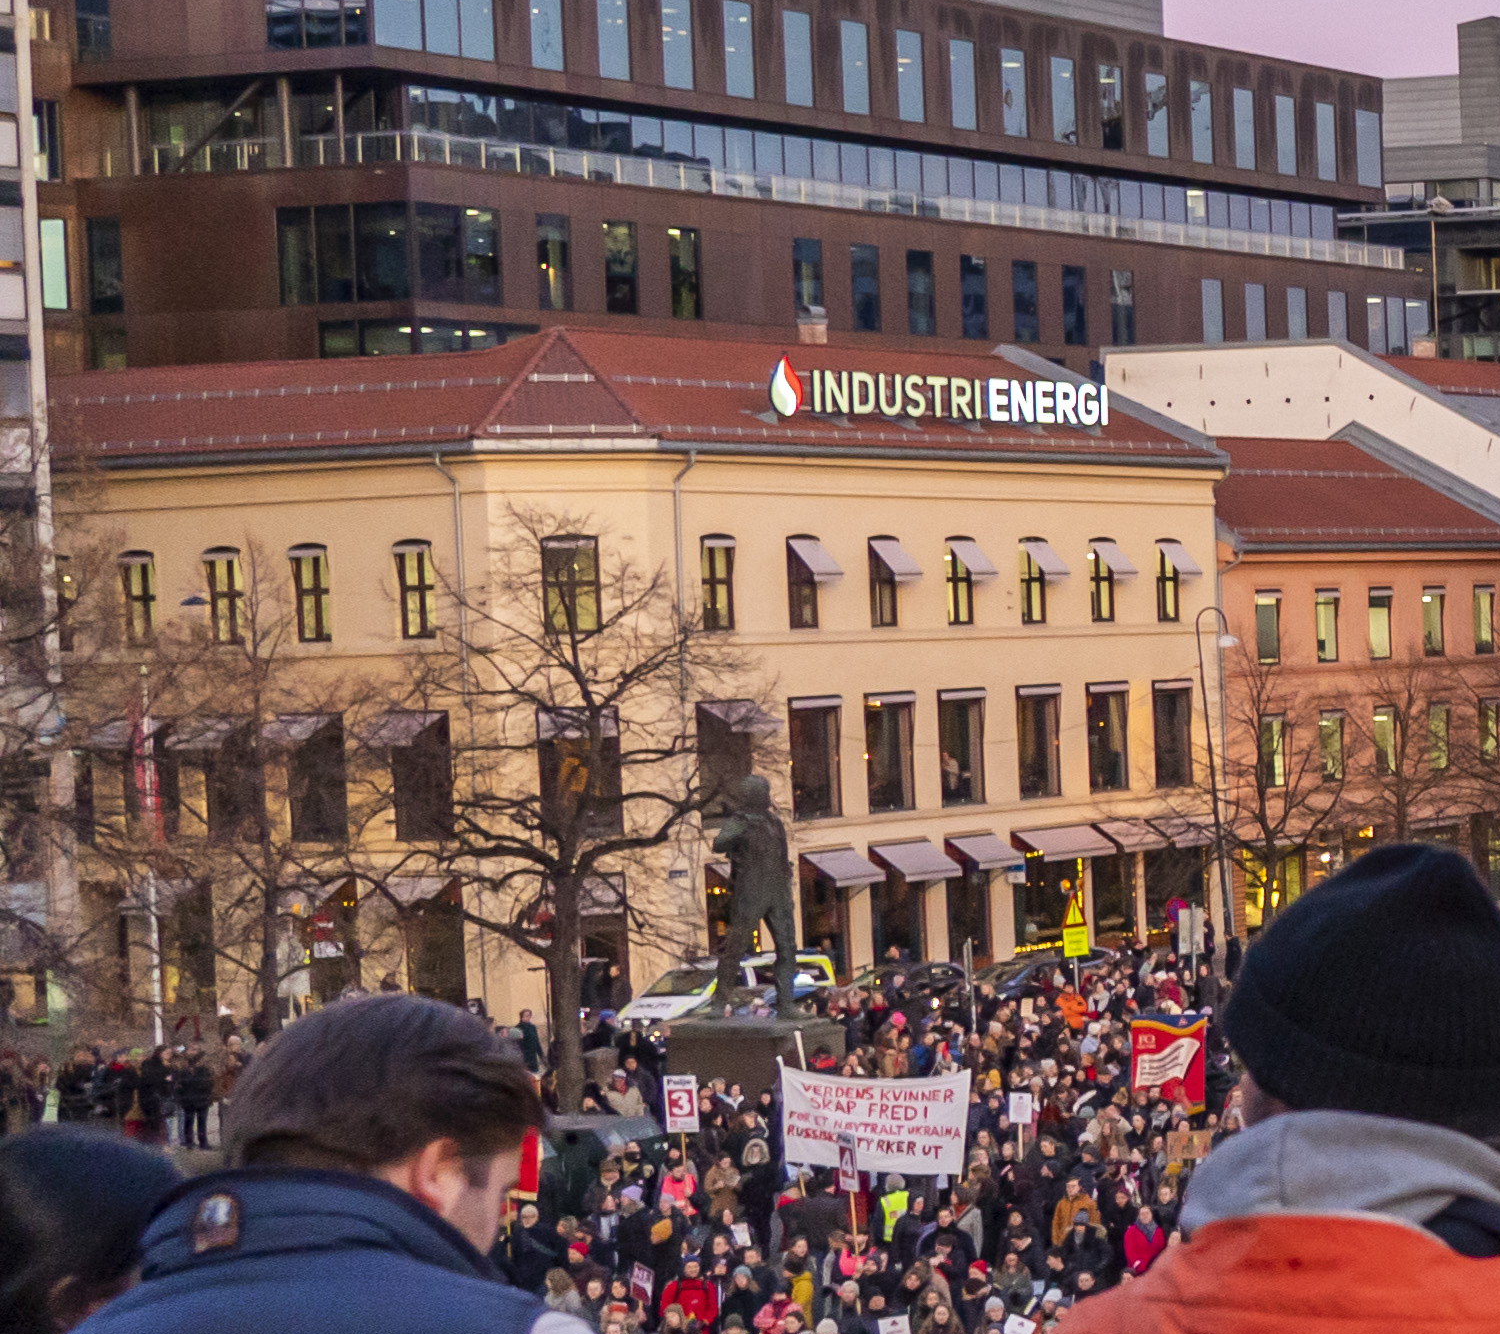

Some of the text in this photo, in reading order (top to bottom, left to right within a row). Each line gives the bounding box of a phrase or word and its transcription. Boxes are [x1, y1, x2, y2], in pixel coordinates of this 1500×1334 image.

[811, 369, 1109, 426] INDUSTRIENERGI
[670, 1091, 691, 1116] 3
[801, 1082, 955, 1103] VERDENS KVINNER
[810, 1097, 856, 1114] SKAP
[787, 1124, 838, 1144] RUSSISK
[857, 1136, 917, 1156] TYRKER
[921, 1145, 943, 1160] UT
[842, 1148, 853, 1175] 4
